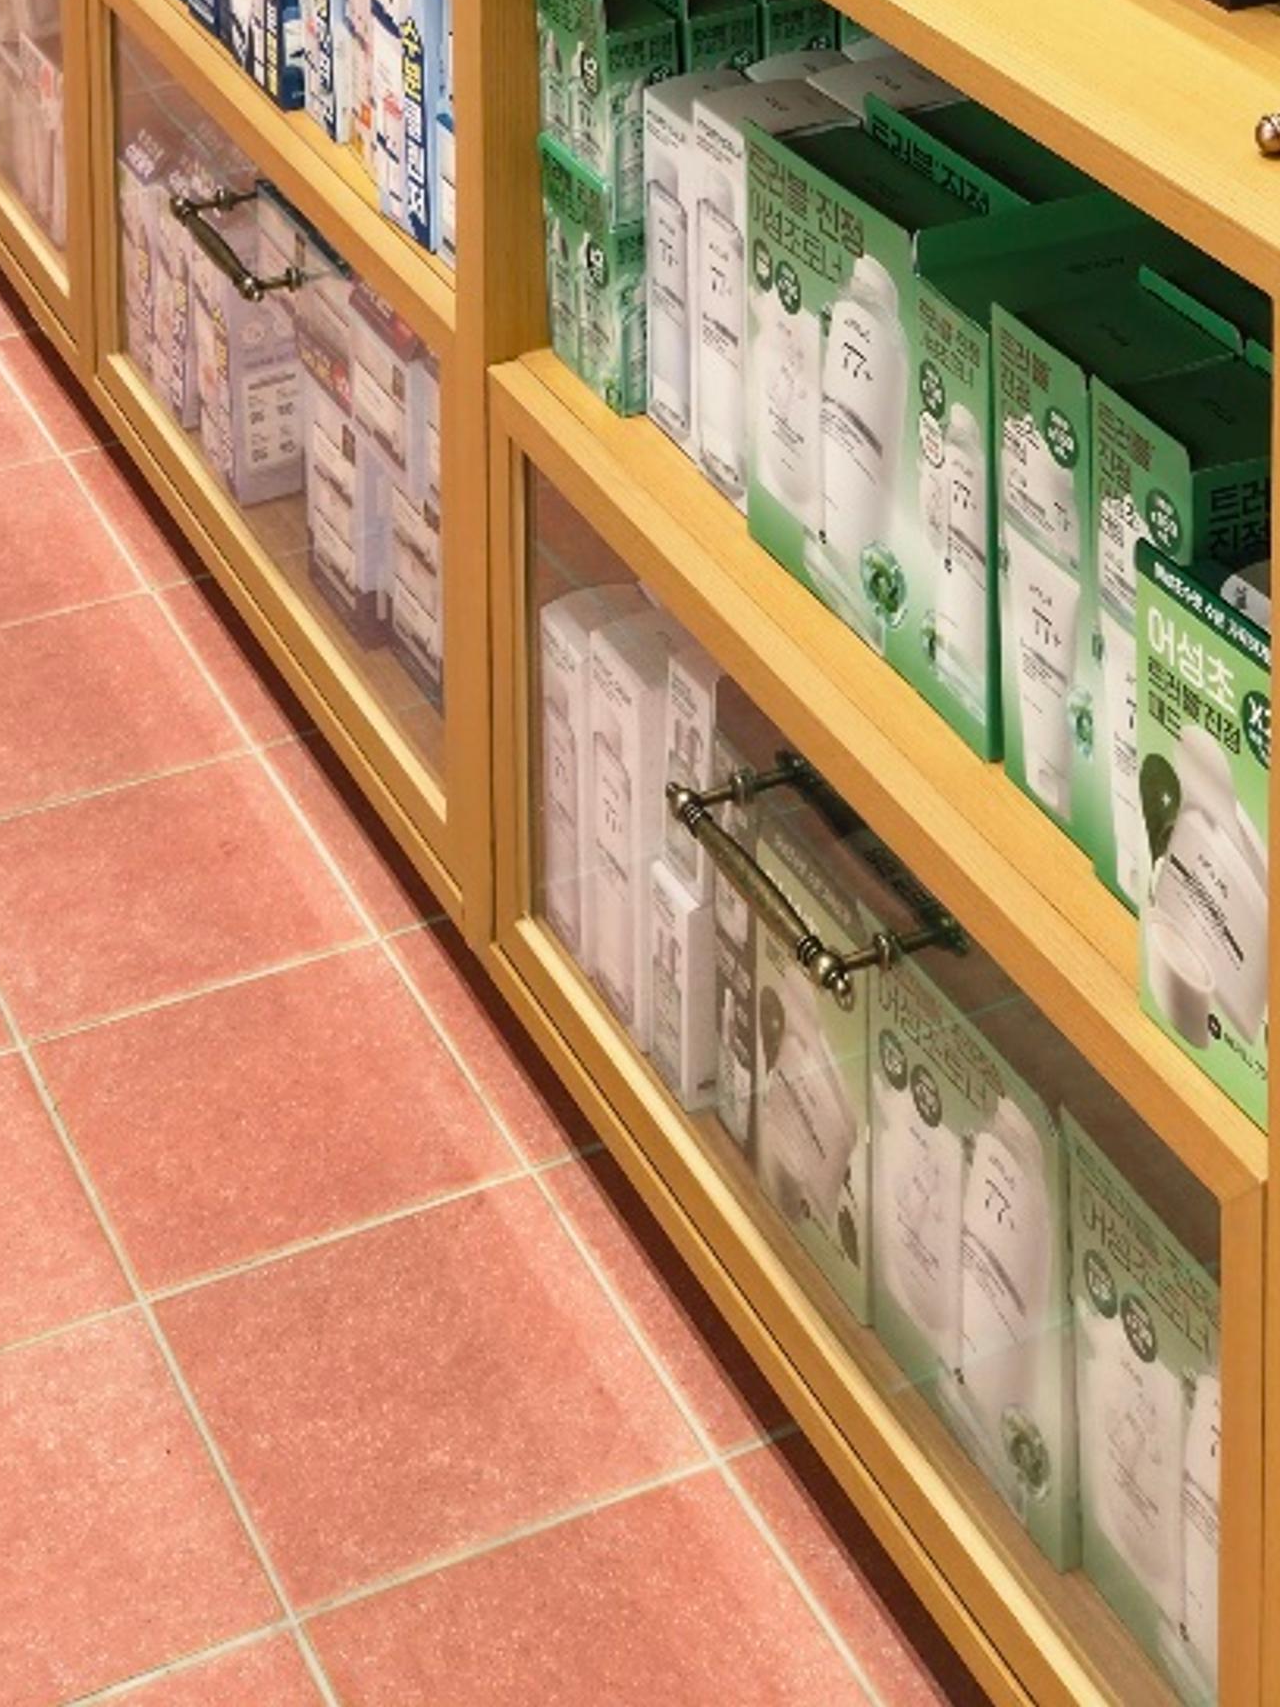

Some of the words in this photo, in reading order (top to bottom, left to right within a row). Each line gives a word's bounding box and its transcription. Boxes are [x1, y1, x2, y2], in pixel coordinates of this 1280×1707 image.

[748, 139, 809, 222] 트러블
[815, 190, 865, 259] 진정
[1147, 605, 1237, 716] 어성초
[1148, 655, 1202, 723] 트러블
[1204, 702, 1241, 756] 진정
